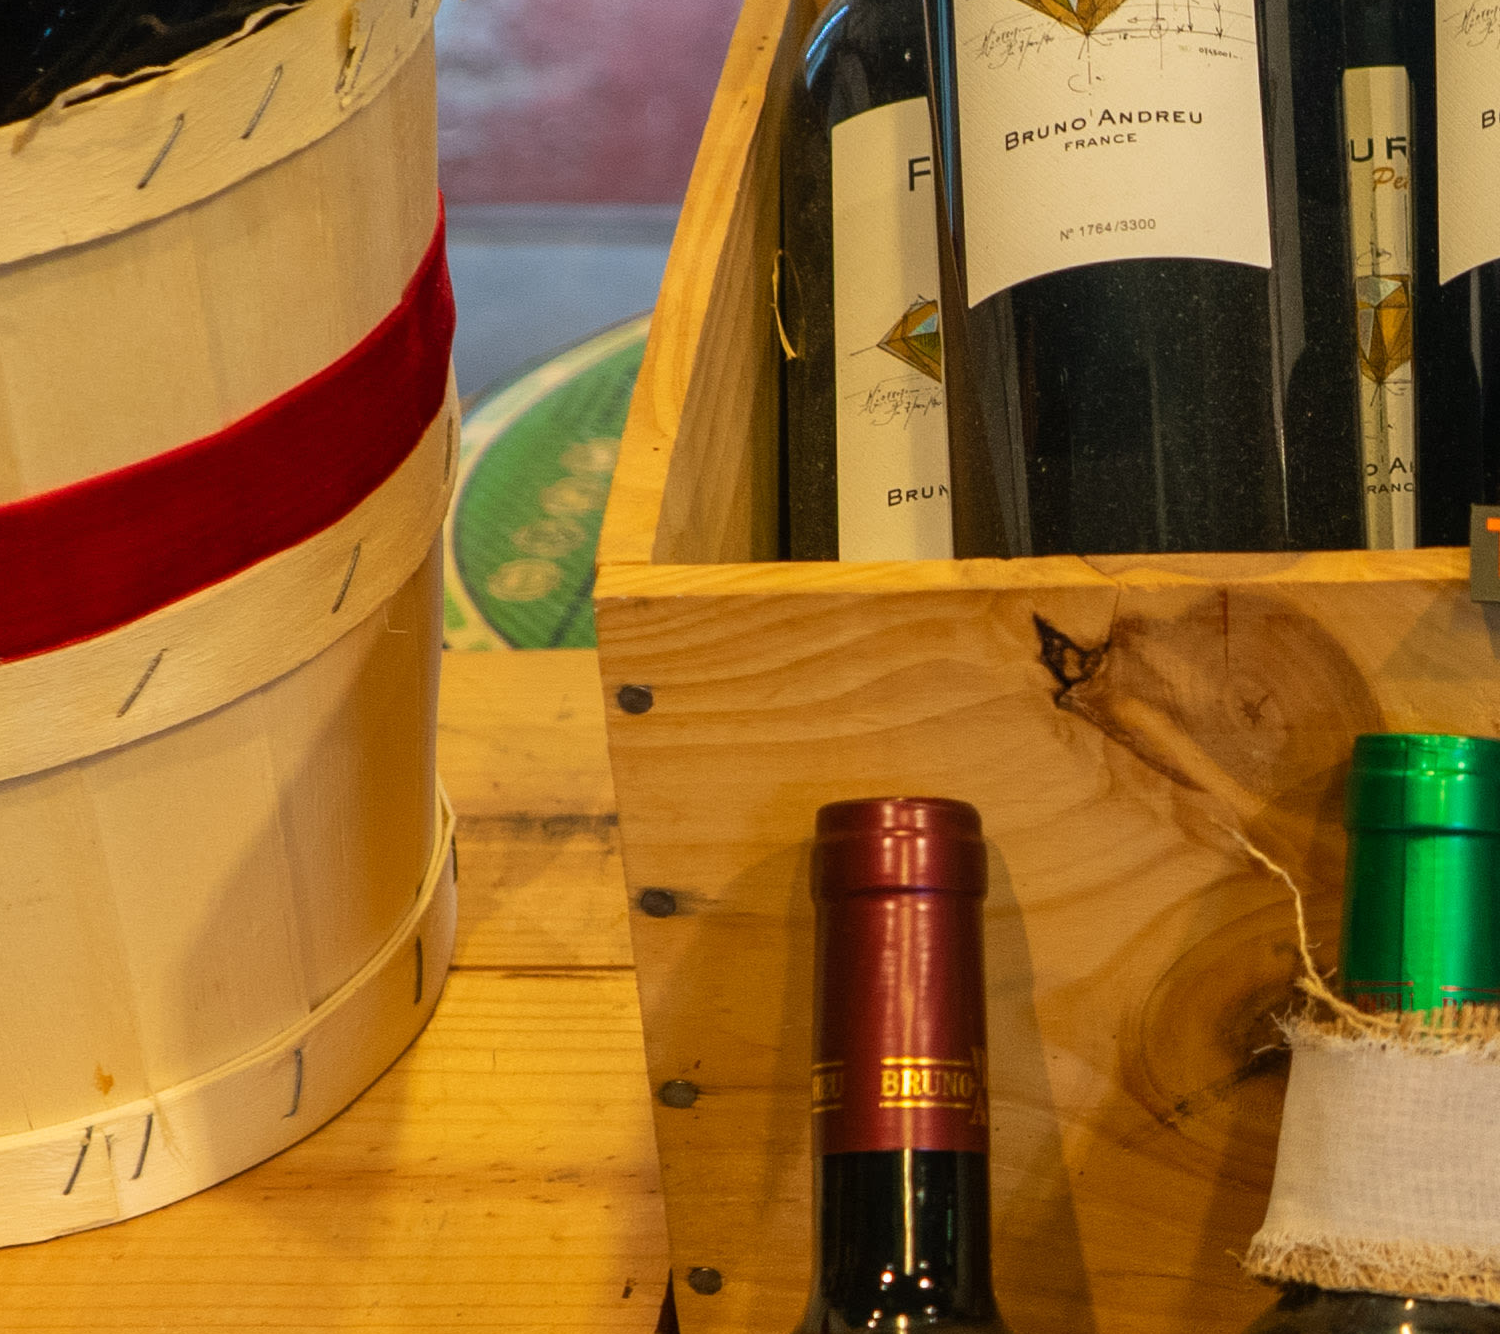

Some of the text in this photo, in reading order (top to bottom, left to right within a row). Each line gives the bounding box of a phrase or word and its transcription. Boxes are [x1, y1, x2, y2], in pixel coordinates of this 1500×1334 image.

[1004, 108, 1203, 151] BRUNO ANDREU
[1064, 132, 1138, 152] FRANCE
[1079, 218, 1156, 236] 1764/3300
[887, 483, 949, 508] BRUN
[879, 1068, 973, 1099] BRUNO
